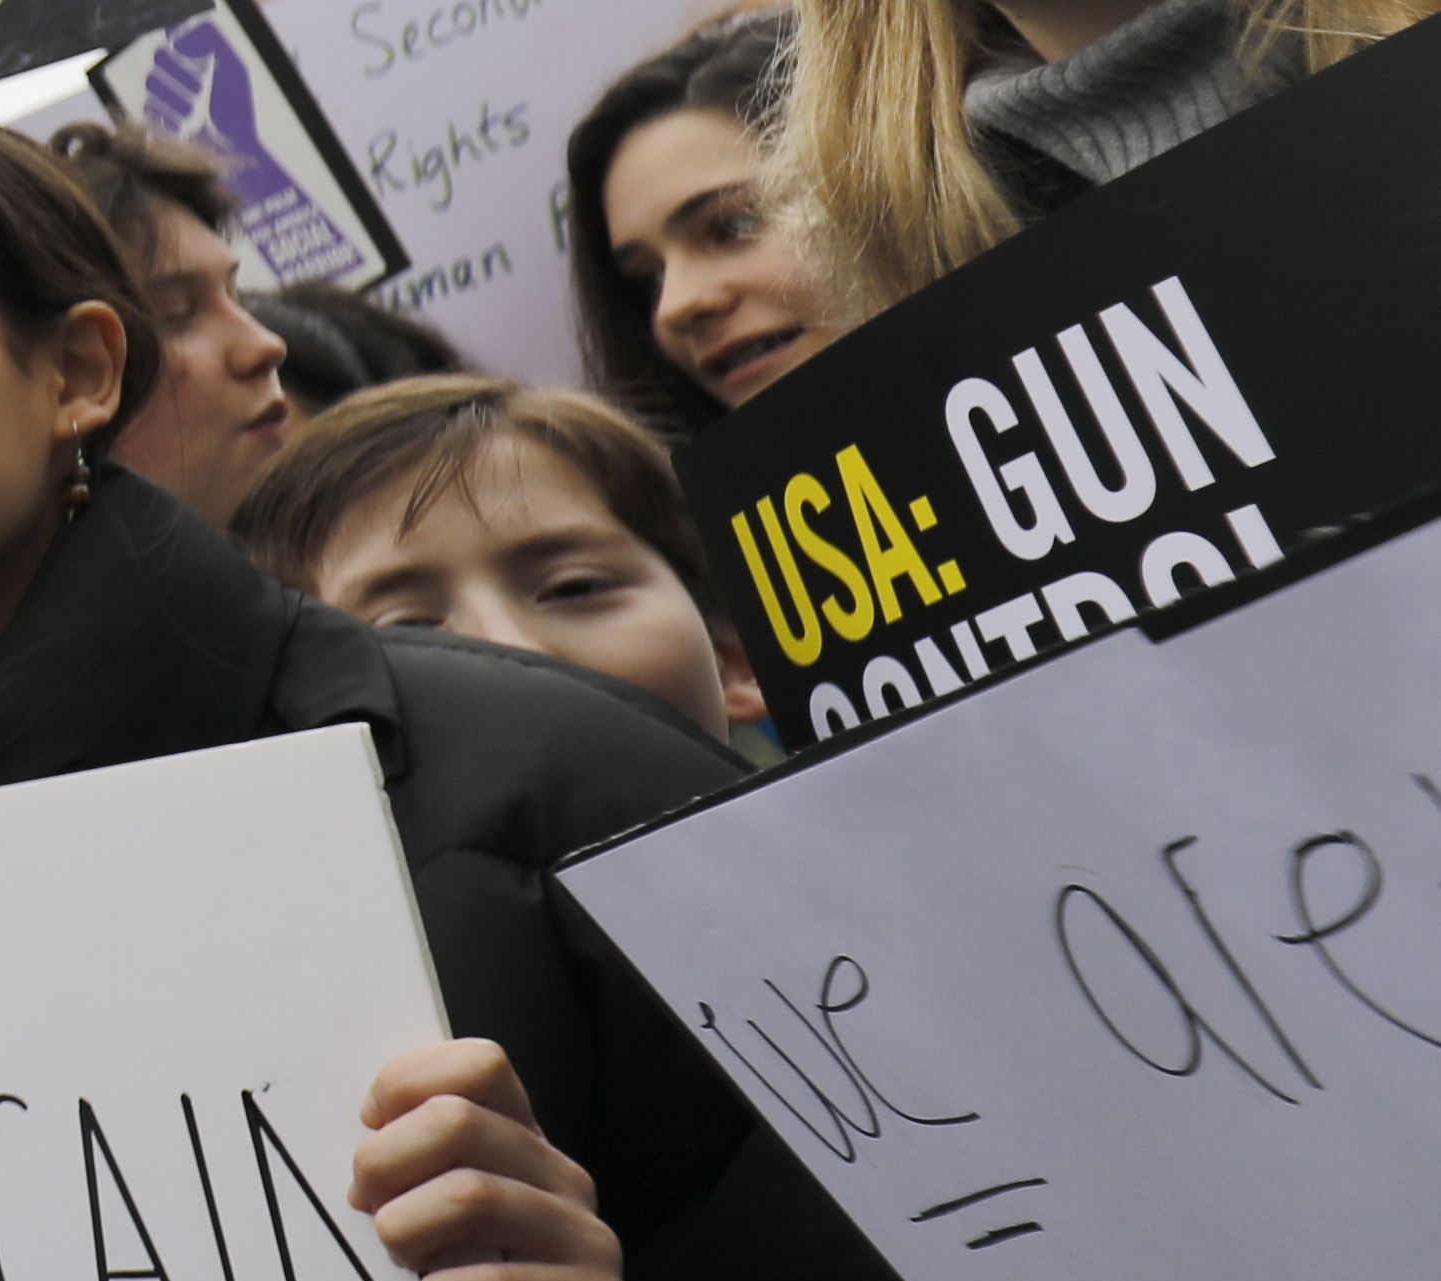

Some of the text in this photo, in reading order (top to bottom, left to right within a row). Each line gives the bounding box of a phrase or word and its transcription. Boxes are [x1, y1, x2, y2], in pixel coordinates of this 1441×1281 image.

[366, 101, 531, 213] Rights
[730, 443, 967, 667] USA:
[944, 275, 1277, 562] GUN
